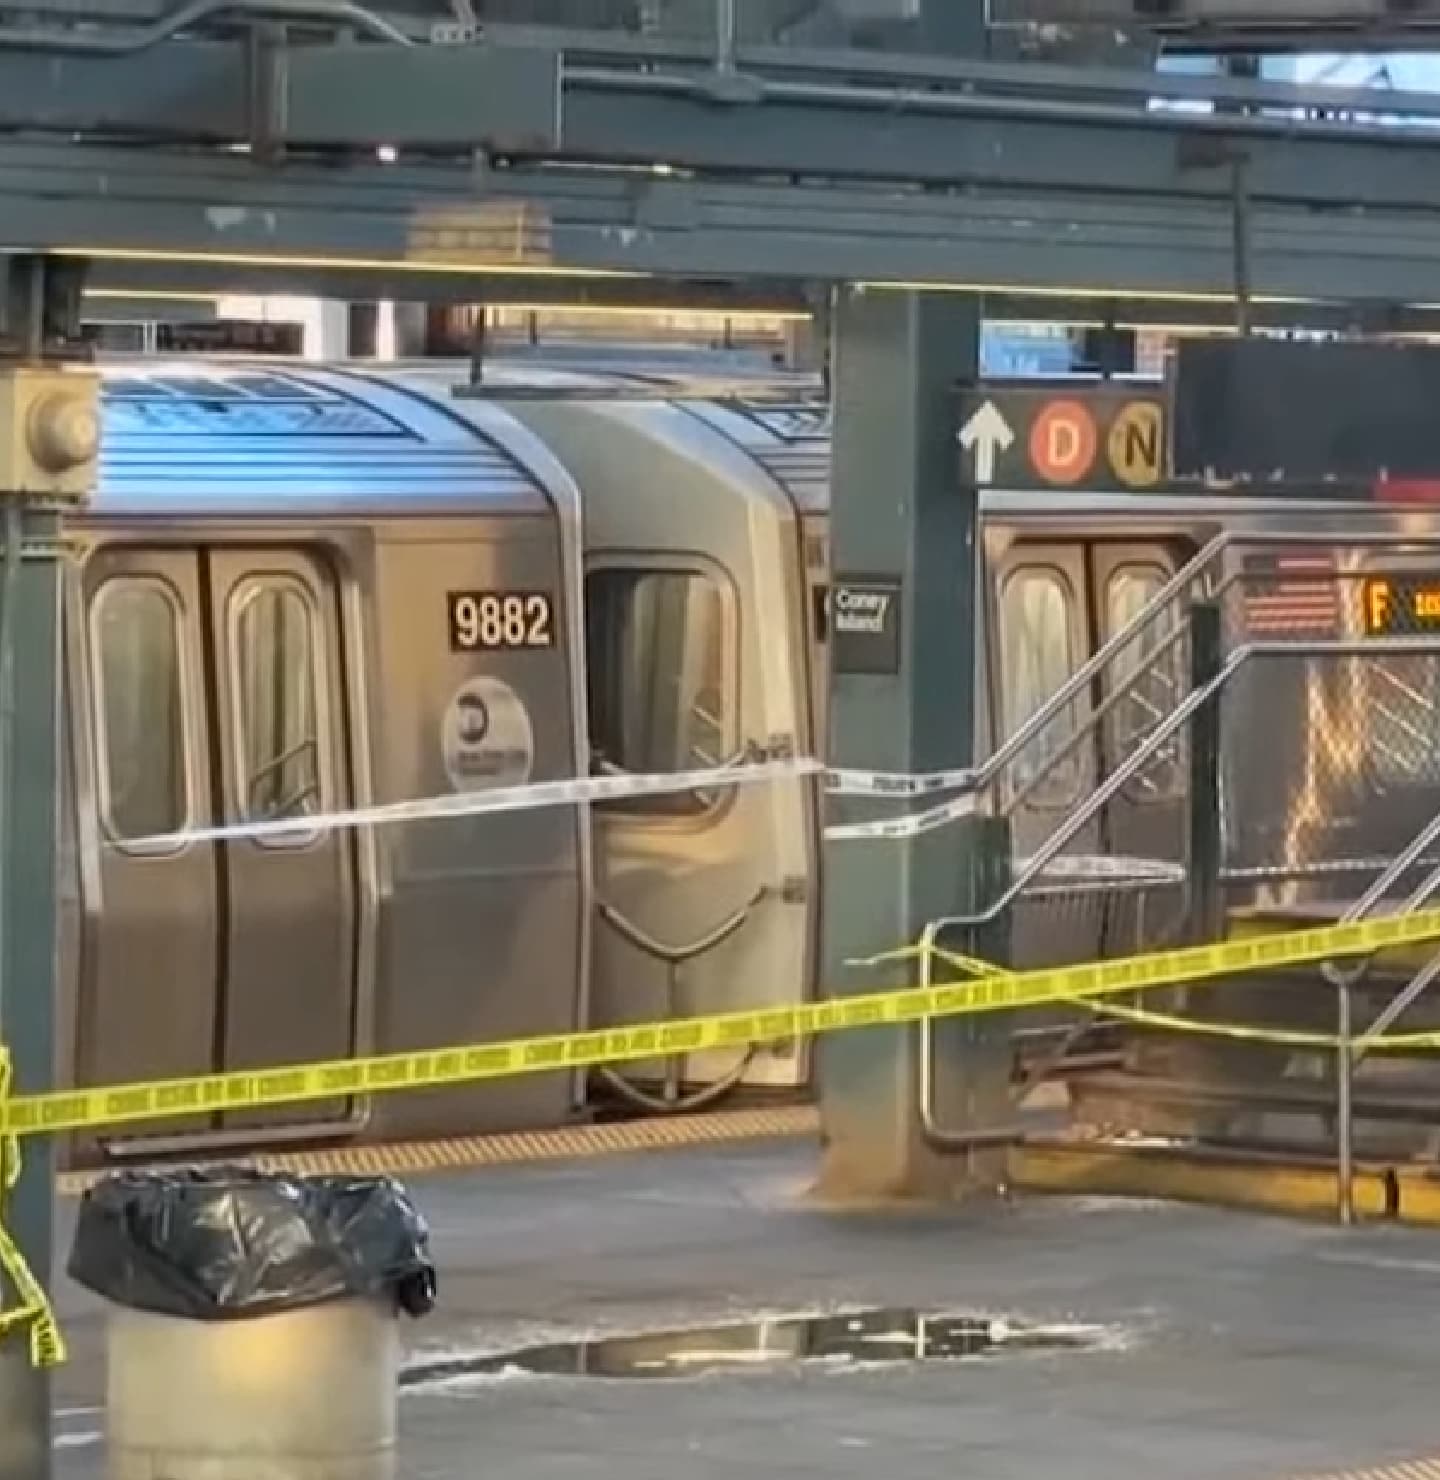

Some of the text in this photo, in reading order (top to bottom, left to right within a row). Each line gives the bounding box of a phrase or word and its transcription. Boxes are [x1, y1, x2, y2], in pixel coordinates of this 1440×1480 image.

[1048, 420, 1157, 466] D N
[456, 597, 550, 646] 9882
[836, 590, 890, 617] Coney
[836, 613, 884, 632] Island
[1368, 581, 1388, 629] F
